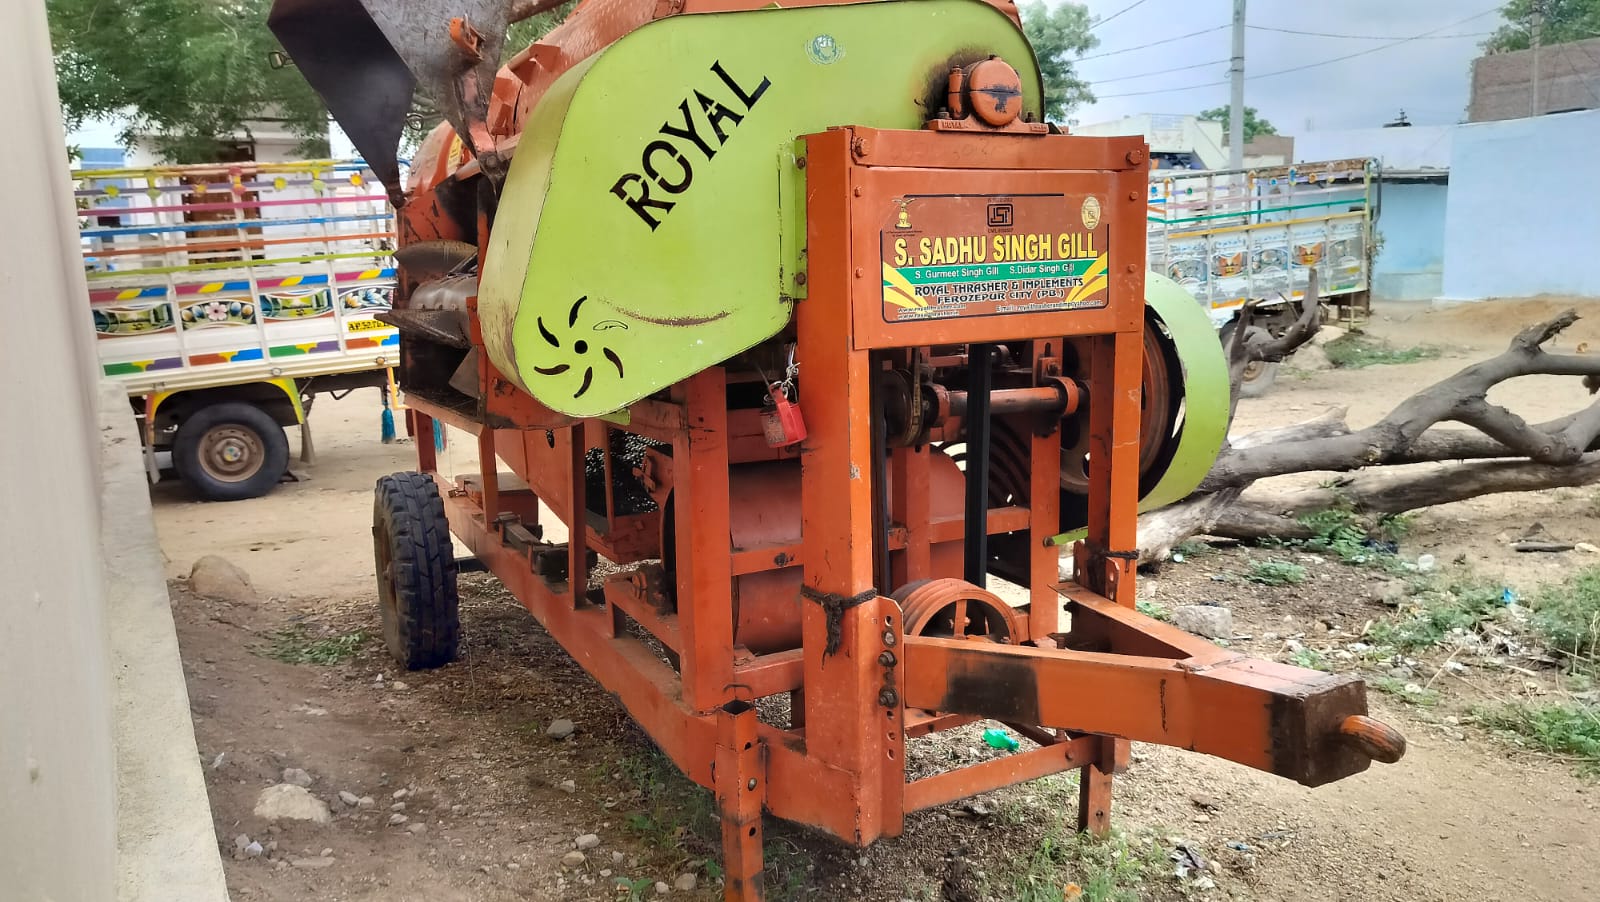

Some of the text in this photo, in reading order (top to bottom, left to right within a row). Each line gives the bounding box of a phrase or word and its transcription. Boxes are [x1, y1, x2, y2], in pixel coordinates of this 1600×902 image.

[609, 59, 772, 232] ROYAL
[894, 232, 1098, 265] S. SADHU SINGH GILL
[914, 270, 922, 279] S.
[925, 269, 959, 279] Gurmeet
[961, 268, 984, 279] Singh
[986, 267, 999, 276] Gill
[1039, 264, 1061, 274] Singh
[915, 278, 1084, 296] ROYAL THRASHER & IMPLEMENTS
[937, 293, 1006, 304] FEROZEPUR
[1009, 290, 1033, 300] CITY
